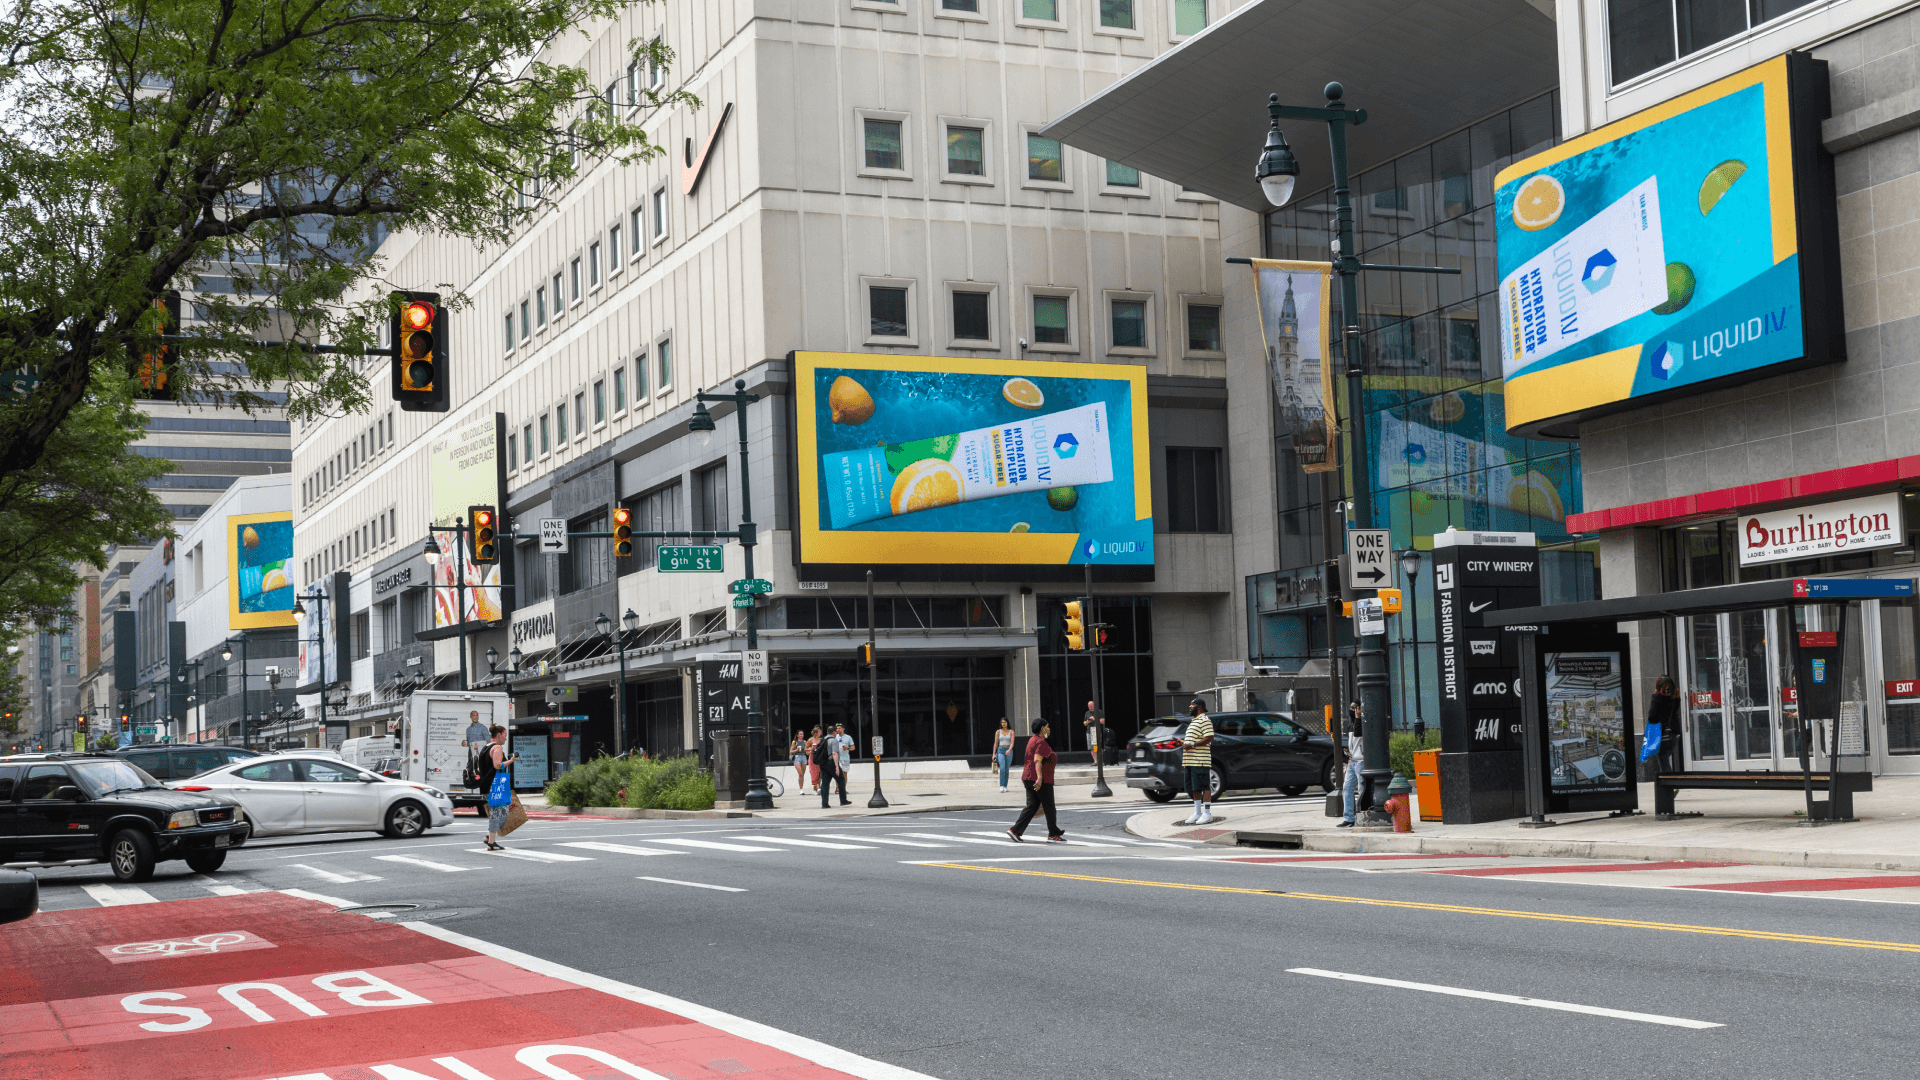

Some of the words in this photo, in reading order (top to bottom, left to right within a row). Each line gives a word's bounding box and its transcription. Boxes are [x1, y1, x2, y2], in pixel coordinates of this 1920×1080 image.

[1552, 239, 1577, 315] LIQUID
[1519, 273, 1536, 354] MULTIPLIER
[1530, 267, 1548, 346] HYDRATION
[1510, 286, 1521, 355] SUGAR-FREE
[1692, 317, 1763, 361] LIQUID
[461, 430, 470, 442] YOU
[470, 424, 483, 439] COULD
[484, 419, 495, 433] SELL
[1031, 418, 1050, 466] LIQUID
[432, 441, 444, 454] WHAT
[454, 444, 470, 459] PERSON
[470, 440, 479, 453] AND
[479, 433, 495, 449] ONLINE
[992, 433, 1005, 482] SUGAR-FREE
[1003, 429, 1018, 484] MULTIPLIER
[1013, 427, 1028, 481] HYDRATION
[459, 458, 470, 471] FROM
[470, 454, 479, 466] ONE
[479, 448, 495, 462] PLACE?
[841, 455, 850, 468] NET
[543, 521, 563, 529] ONE
[543, 530, 563, 538] WAY
[1746, 512, 1891, 550] Burlington
[673, 548, 679, 556] S
[702, 548, 709, 556] N
[1103, 541, 1136, 556] LIQUID
[1356, 534, 1384, 548] ONE
[1747, 550, 1766, 559] LADIES
[1773, 547, 1789, 555] MENS
[1796, 544, 1809, 552] KIDS
[1817, 541, 1832, 549] BABY
[1849, 536, 1866, 545] HOME
[1873, 533, 1892, 541] COATS
[670, 556, 689, 570] 9th
[696, 556, 711, 570] St
[1356, 550, 1385, 563] WAY
[1467, 561, 1490, 572] CITY
[1492, 561, 1534, 572] WINERY
[761, 584, 771, 592] St
[512, 612, 554, 645] SEPHORA
[1441, 591, 1454, 643] FASHION
[280, 667, 299, 677] FASHIO
[718, 664, 739, 678] H&M
[1443, 646, 1457, 700] DISTRICT
[1473, 682, 1507, 695] amc
[1697, 693, 1712, 703] EXIT
[1896, 683, 1913, 693] EXIT
[709, 706, 724, 718] F21
[1474, 718, 1499, 741] H&M
[1510, 724, 1524, 733] GU
[120, 970, 434, 1033] BUS
